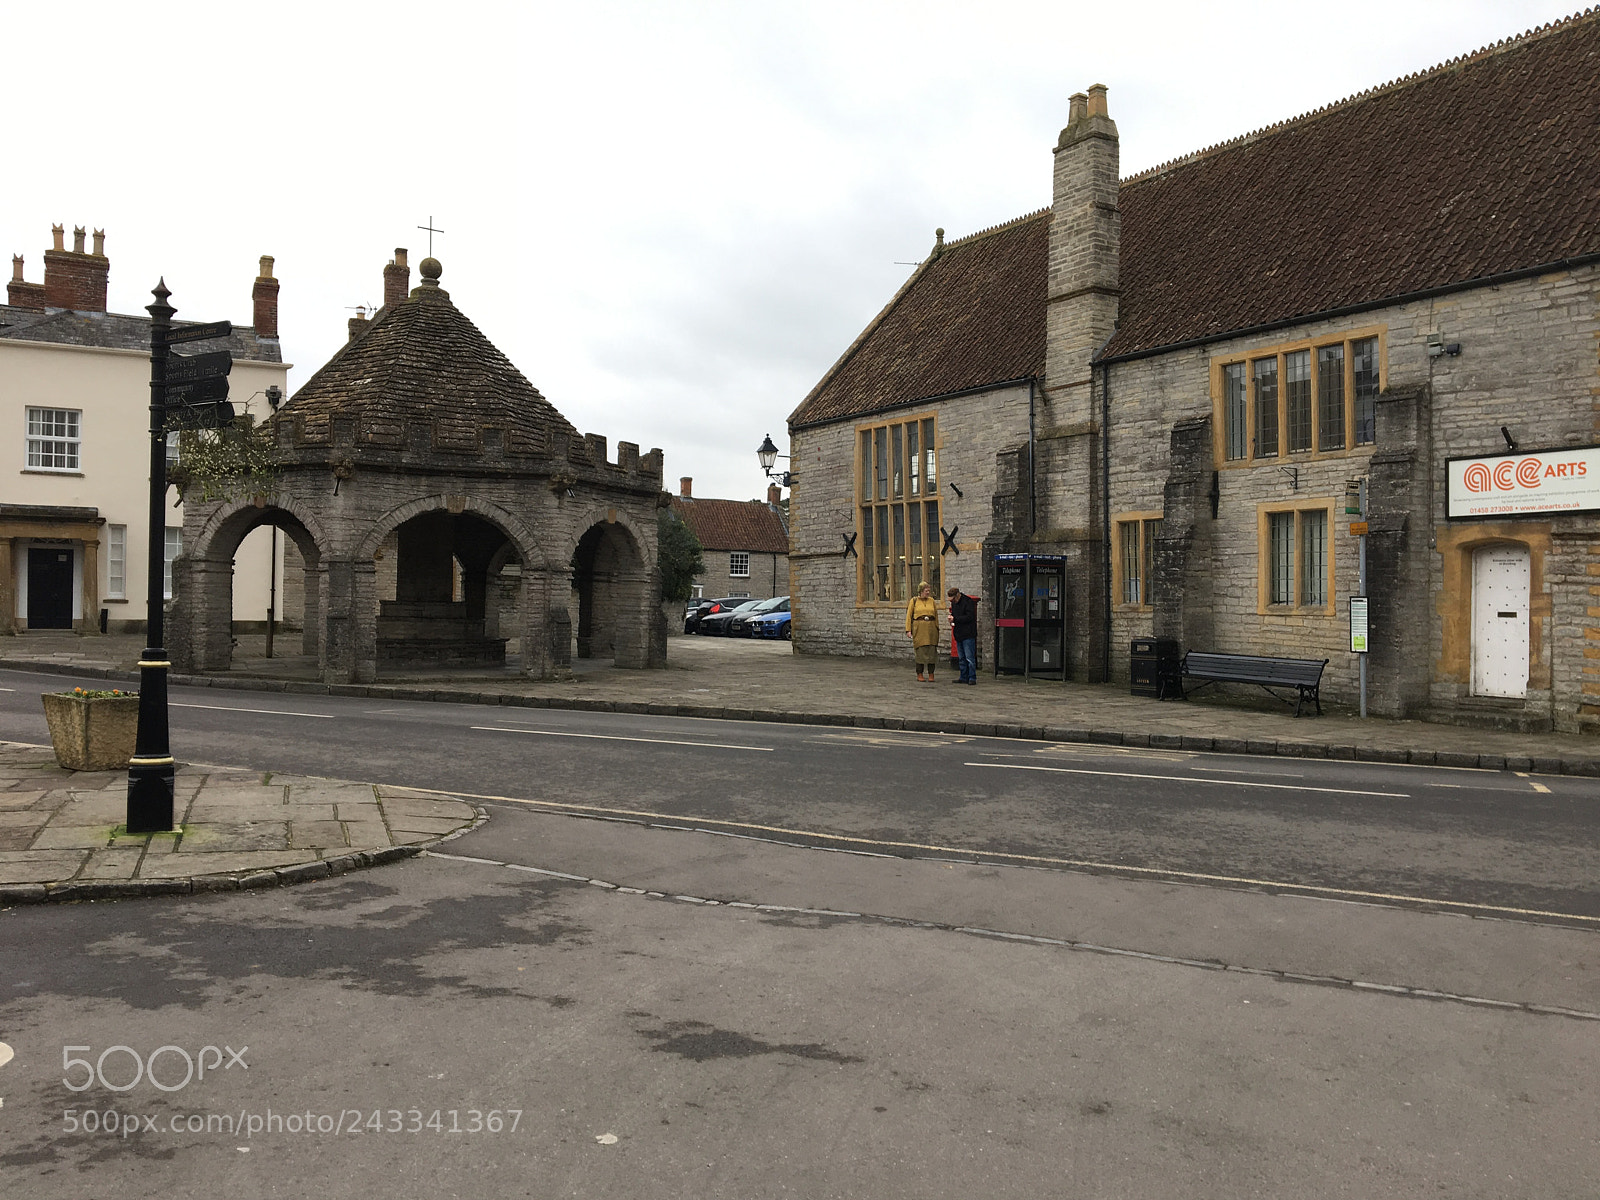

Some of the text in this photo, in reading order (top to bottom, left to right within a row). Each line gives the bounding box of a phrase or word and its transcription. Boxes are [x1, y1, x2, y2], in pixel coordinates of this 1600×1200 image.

[1463, 457, 1587, 493] ace ARTS
[1519, 501, 1581, 512] www.acearts.co.uk
